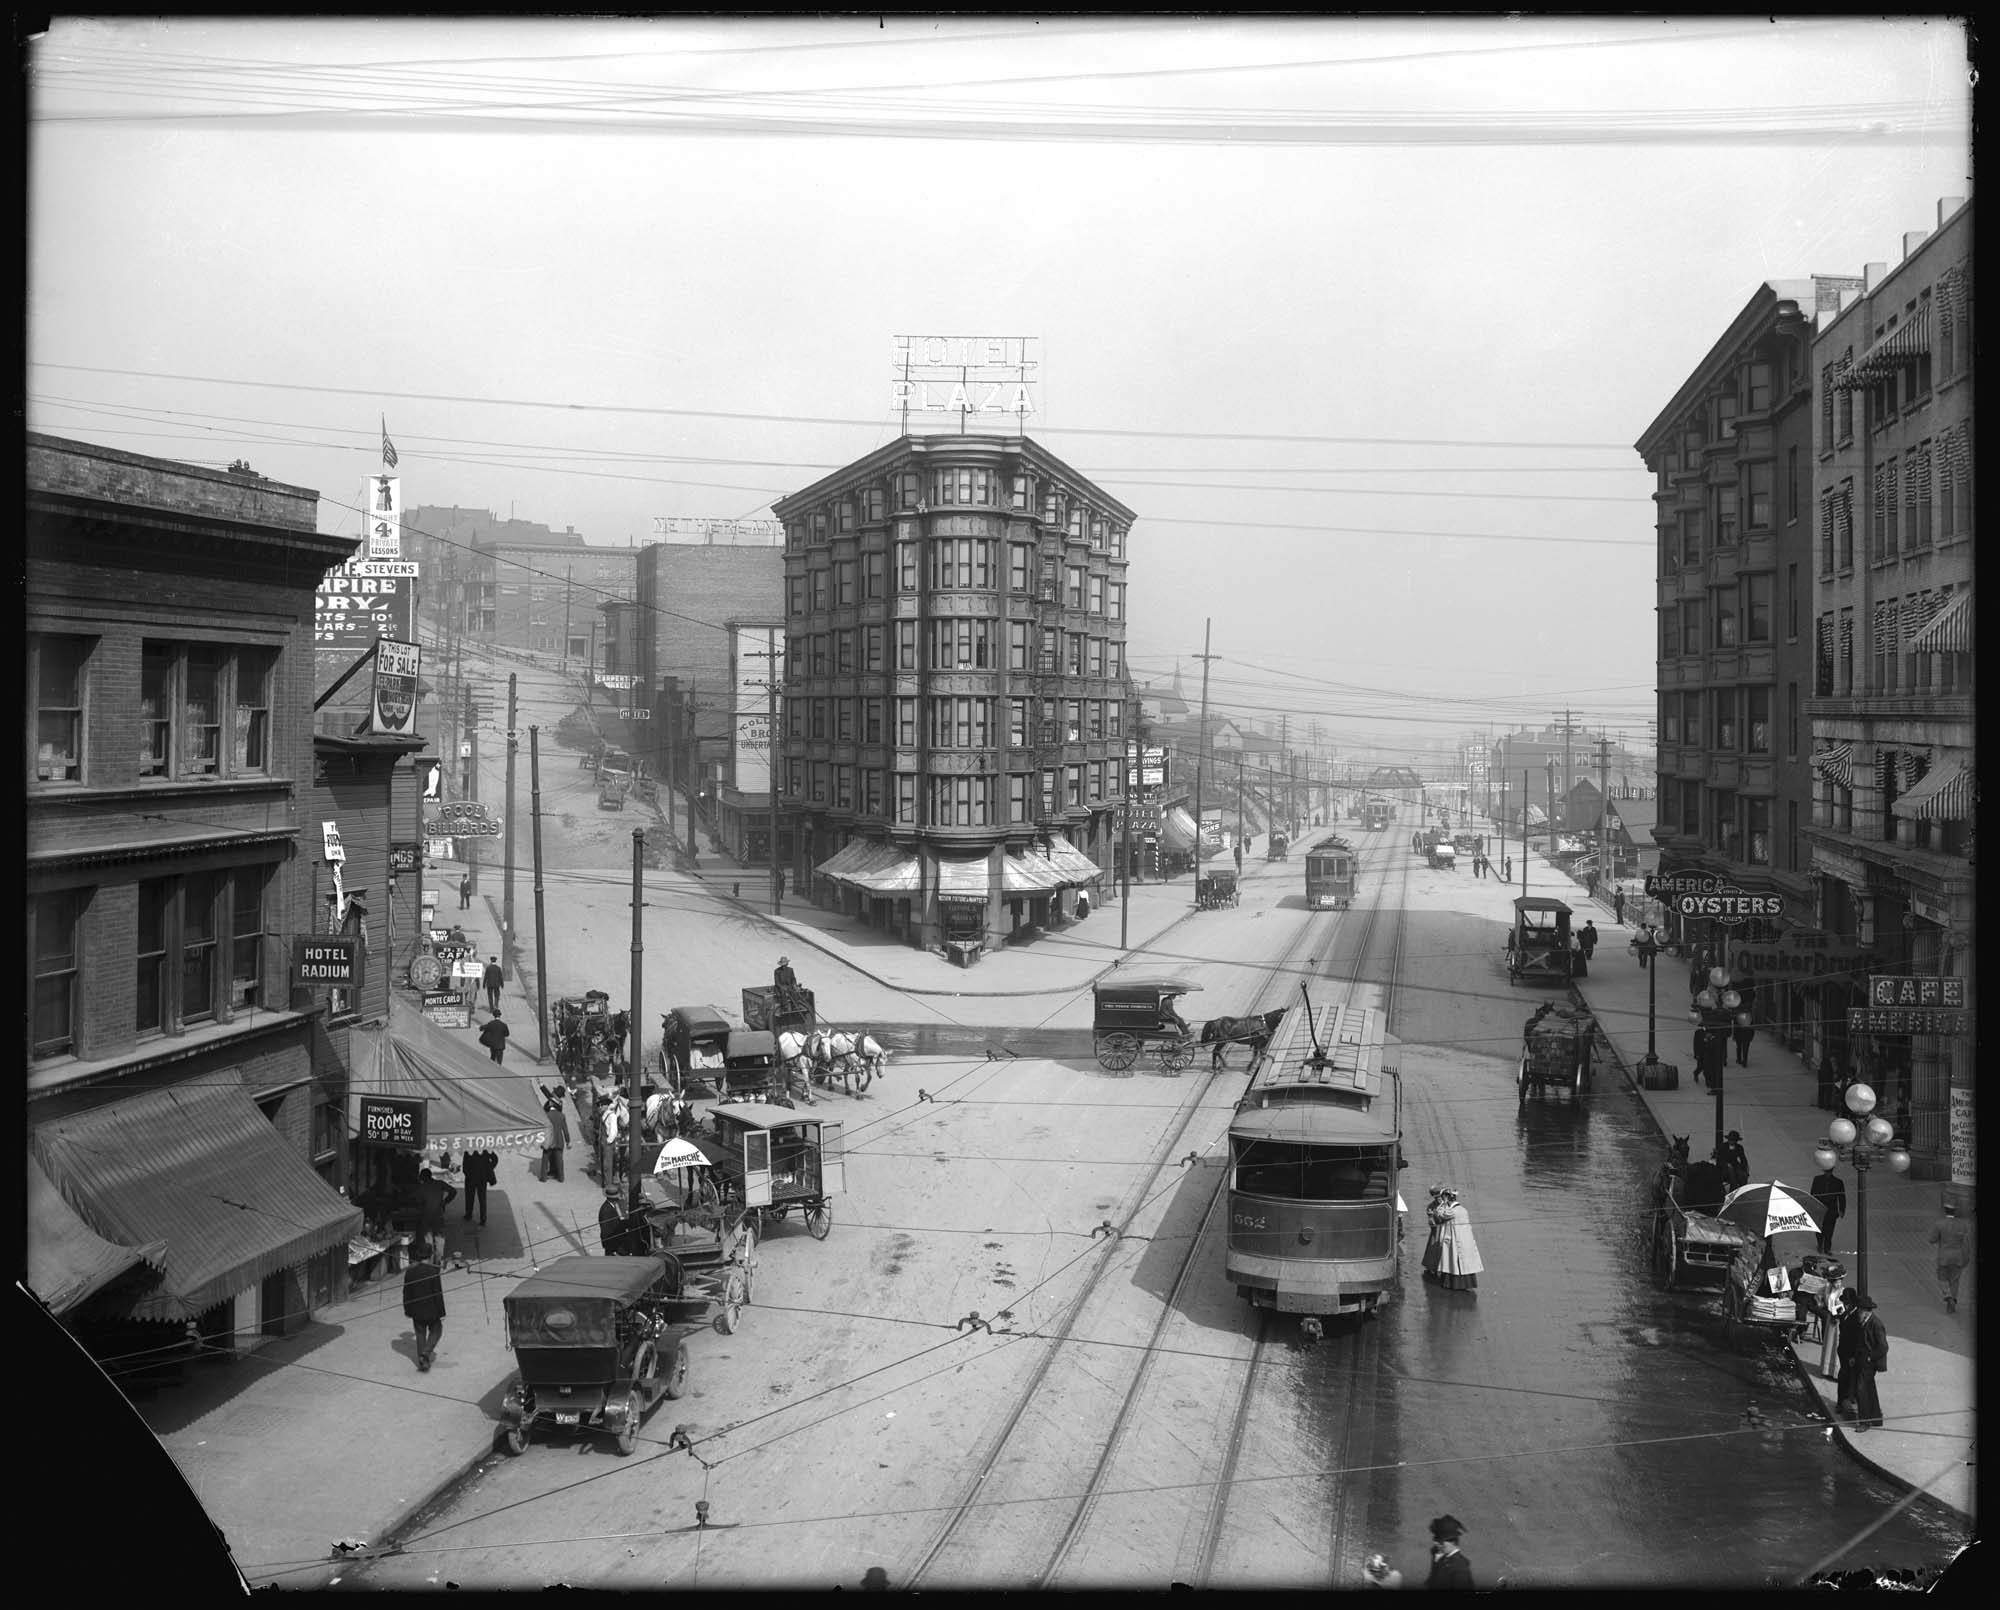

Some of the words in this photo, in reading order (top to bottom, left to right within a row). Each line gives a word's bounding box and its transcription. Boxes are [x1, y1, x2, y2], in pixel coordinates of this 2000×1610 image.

[893, 335, 1037, 368] HOTEL
[892, 381, 1035, 413] PLAZA
[375, 522, 392, 537] 4
[371, 547, 398, 555] LESSONS
[365, 564, 415, 575] STEVENS
[388, 644, 400, 654] THIS
[401, 646, 411, 656] LOT
[379, 654, 395, 672] FOR
[396, 657, 417, 675] SALE
[442, 804, 481, 818] POOL
[428, 822, 498, 834] BILLIARDS
[1649, 877, 1724, 892] AMERICA
[1681, 896, 1781, 914] OYSTERS
[305, 948, 348, 961] HOTEL
[301, 964, 350, 979] RADIUM
[1876, 980, 1961, 1005] CAFE
[424, 997, 443, 1006] MONTE
[443, 995, 461, 1004] CARLO
[367, 1113, 412, 1129] ROOMS
[452, 1138, 461, 1149] &
[466, 1132, 546, 1148] TOBACCOS
[671, 1150, 704, 1163] MARCHE
[1767, 1214, 1778, 1222] THE
[1778, 1211, 1812, 1228] MARCHE
